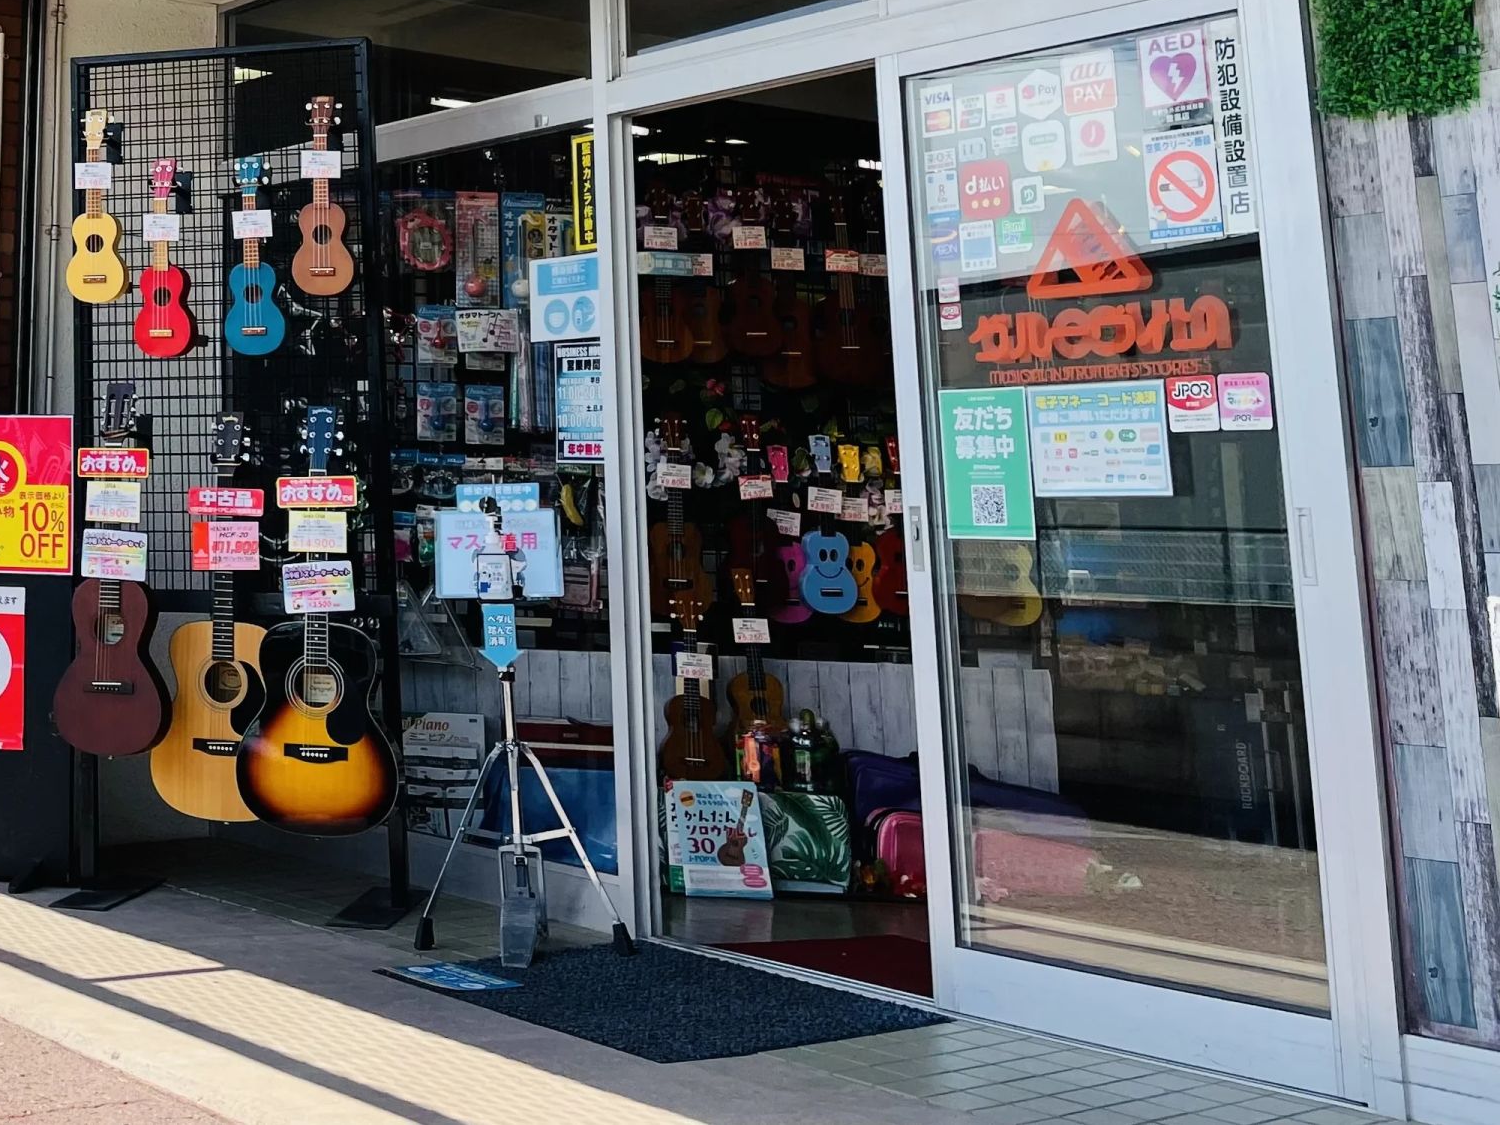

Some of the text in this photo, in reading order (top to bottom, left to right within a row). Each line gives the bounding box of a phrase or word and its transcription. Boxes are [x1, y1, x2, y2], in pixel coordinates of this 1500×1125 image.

[1149, 33, 1195, 55] AED
[925, 92, 950, 106] VISA
[1037, 84, 1057, 95] Pay
[1073, 83, 1105, 103] PAY
[1215, 37, 1250, 215] 防犯設備設置店
[965, 176, 1005, 195] d払い
[1174, 383, 1210, 397] JPQR
[953, 405, 1012, 431] 友だち
[568, 444, 602, 455] 年中無休
[955, 435, 1015, 459] 募集中
[199, 489, 253, 508] 中古品
[19, 501, 65, 533] 10%
[20, 533, 64, 559] OFF
[448, 532, 537, 551] マス着用
[415, 718, 450, 732] Piano
[684, 809, 736, 824] かんたん
[687, 837, 716, 855] 30
